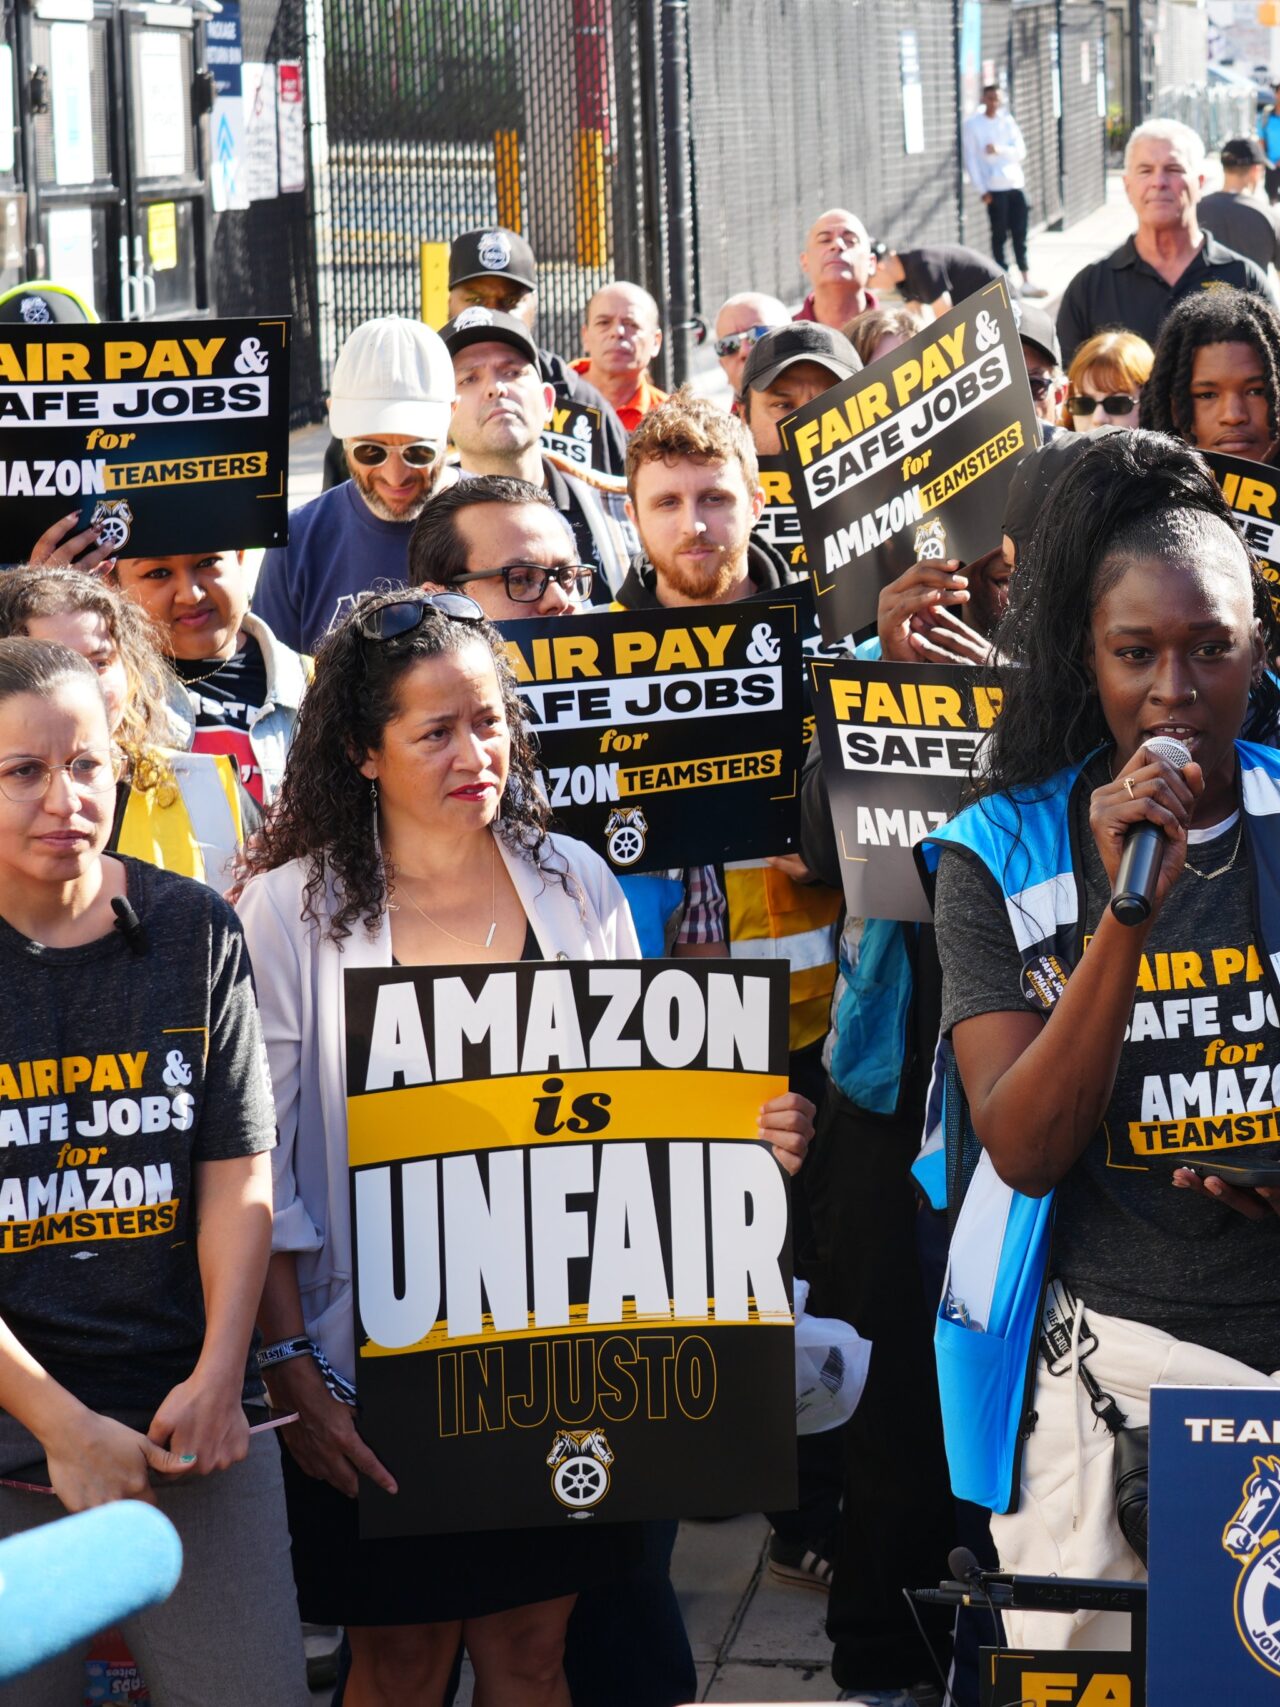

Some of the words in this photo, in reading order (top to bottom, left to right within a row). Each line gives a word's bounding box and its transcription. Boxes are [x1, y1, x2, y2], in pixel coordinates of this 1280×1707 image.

[0, 343, 92, 382] AIR
[104, 338, 226, 380] PAY
[234, 337, 269, 375] &
[0, 391, 99, 420] AFE
[113, 383, 261, 418] JOBS
[794, 382, 894, 466] FAIR
[892, 322, 967, 407] PAY
[975, 310, 1000, 352] &
[85, 428, 136, 450] for
[811, 421, 902, 497] SAFE
[910, 355, 1005, 438] JOBS
[0, 459, 106, 497] AZON
[110, 455, 261, 486] TEAMSTERS
[901, 449, 933, 481] for
[823, 483, 924, 575] AMAZON
[922, 427, 1020, 507] TEAMSTERS
[1223, 473, 1278, 519] IR
[505, 636, 602, 682] AIR
[612, 624, 737, 675] PAY
[746, 622, 781, 664] &
[525, 687, 612, 725] AFE
[625, 674, 776, 716] JOBS
[829, 679, 967, 728] FAIR
[600, 729, 649, 753] for
[847, 732, 980, 770] SAFE
[535, 762, 620, 808] AZON
[623, 754, 776, 792] TEAMSTERS
[1052, 981, 1064, 996] JO
[1058, 973, 1068, 986] PA
[1135, 951, 1206, 991] AIR
[1214, 945, 1264, 986] PA
[364, 968, 771, 1091] AMAZON
[1232, 992, 1280, 1033] JO
[0, 1059, 58, 1100] AIR
[61, 1051, 149, 1094] PAY
[162, 1050, 193, 1087] &
[1204, 1039, 1264, 1067] for
[0, 1102, 69, 1148] AFE
[75, 1093, 195, 1137] JOBS
[533, 1077, 612, 1136] is
[56, 1143, 108, 1169] for
[0, 1162, 174, 1223] AMAZON
[354, 1142, 795, 1349] UNFAIR
[437, 1334, 717, 1438] INJUSTO
[1021, 1671, 1131, 1707] FA
